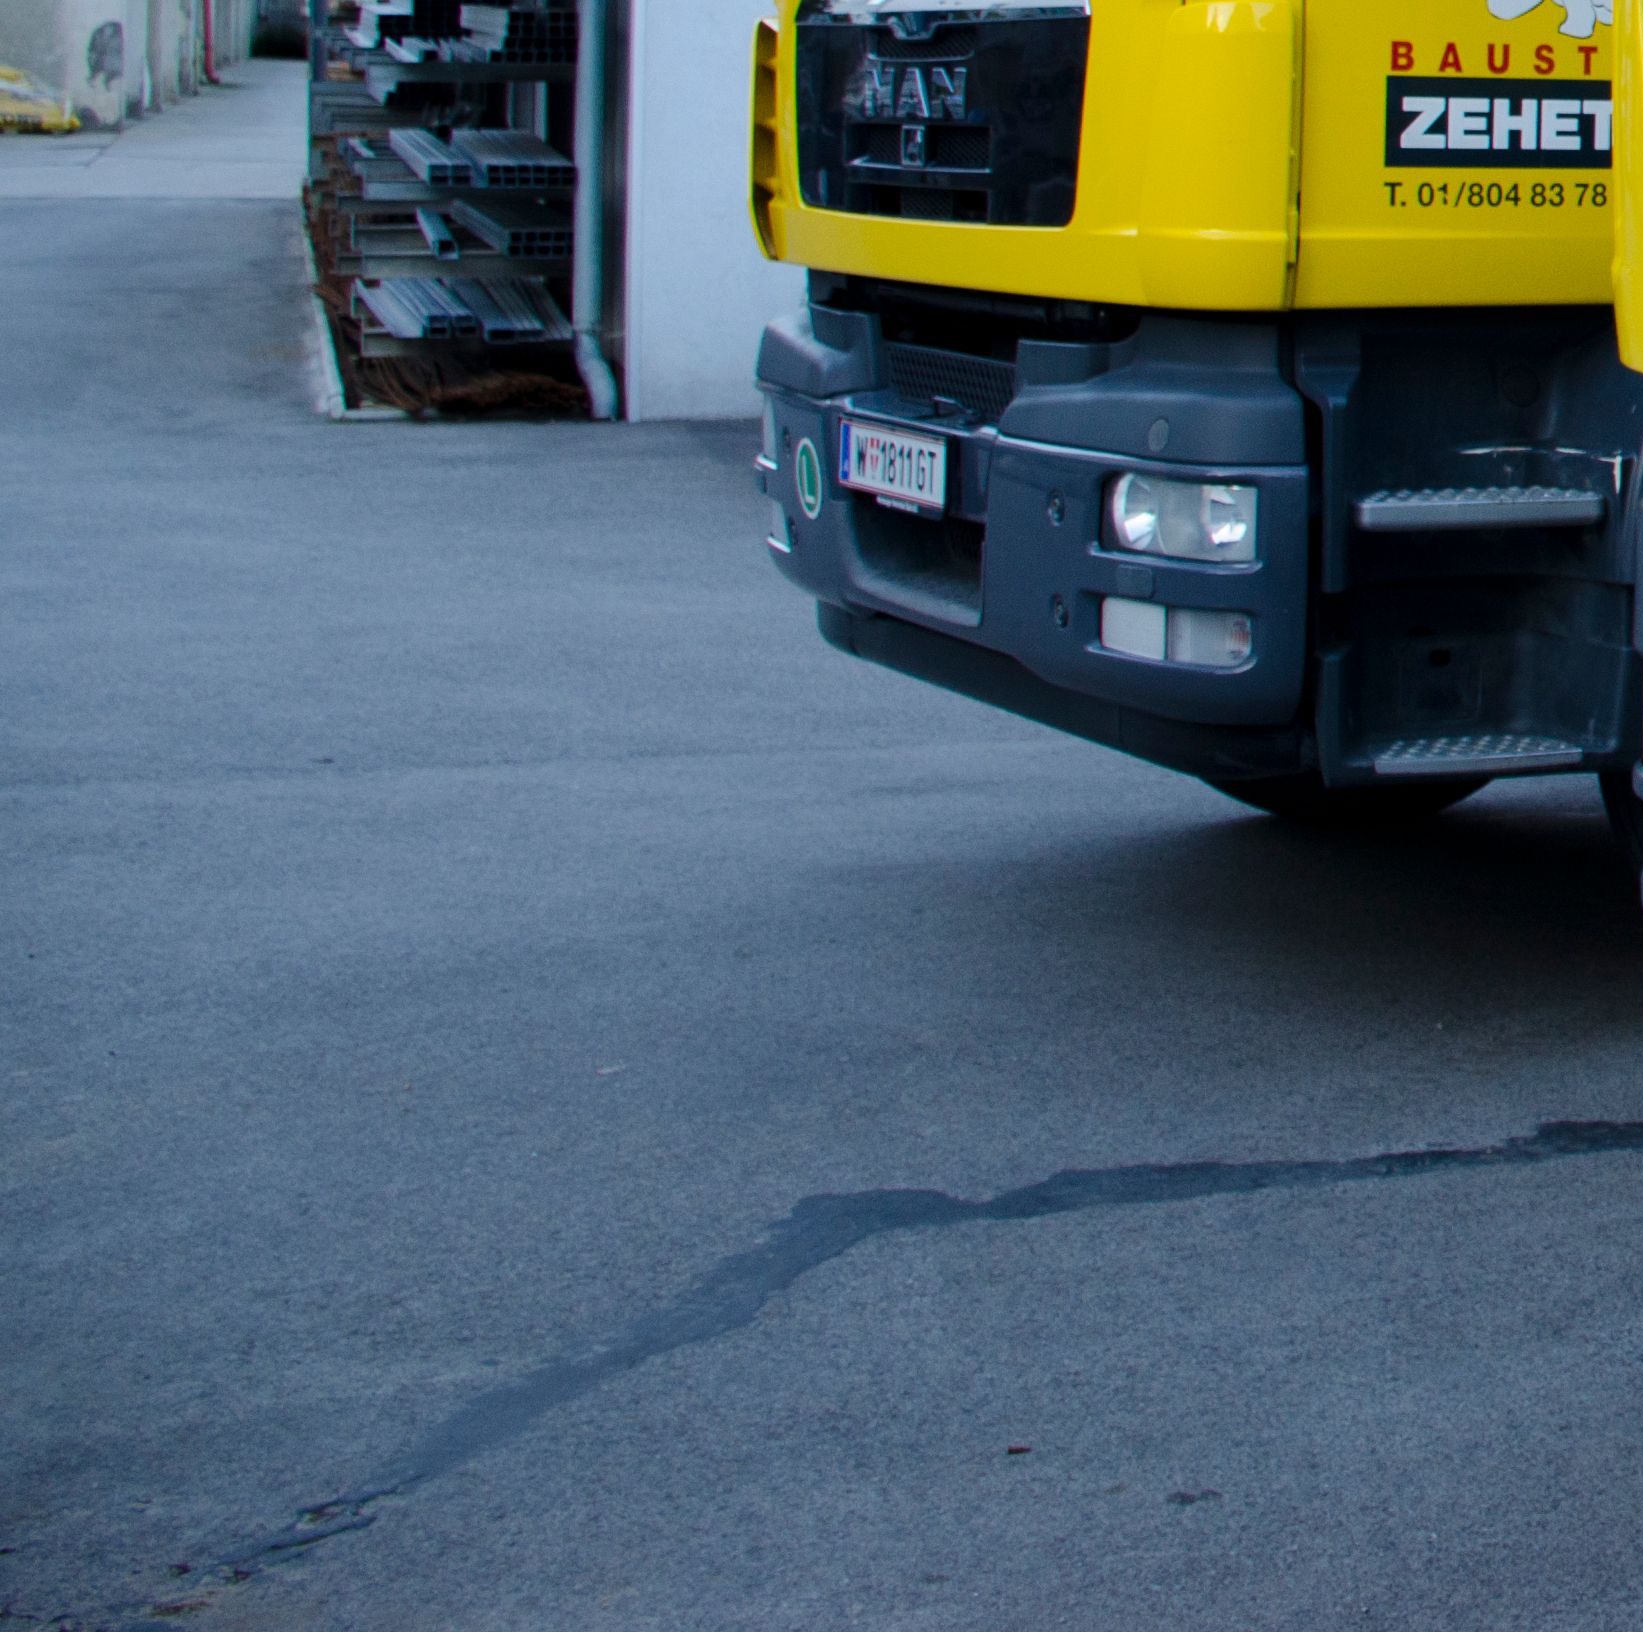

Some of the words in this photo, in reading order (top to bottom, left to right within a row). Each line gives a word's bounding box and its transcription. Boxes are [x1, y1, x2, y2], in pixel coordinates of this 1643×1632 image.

[1390, 40, 1599, 76] BAUST
[1400, 95, 1614, 151] ZEHET
[1383, 181, 1407, 206] T.
[1417, 181, 1522, 208] 01/804
[1530, 182, 1565, 207] 83
[1574, 182, 1608, 207] 78
[856, 434, 868, 478] W
[881, 438, 914, 491] 1811
[916, 448, 937, 494] GT
